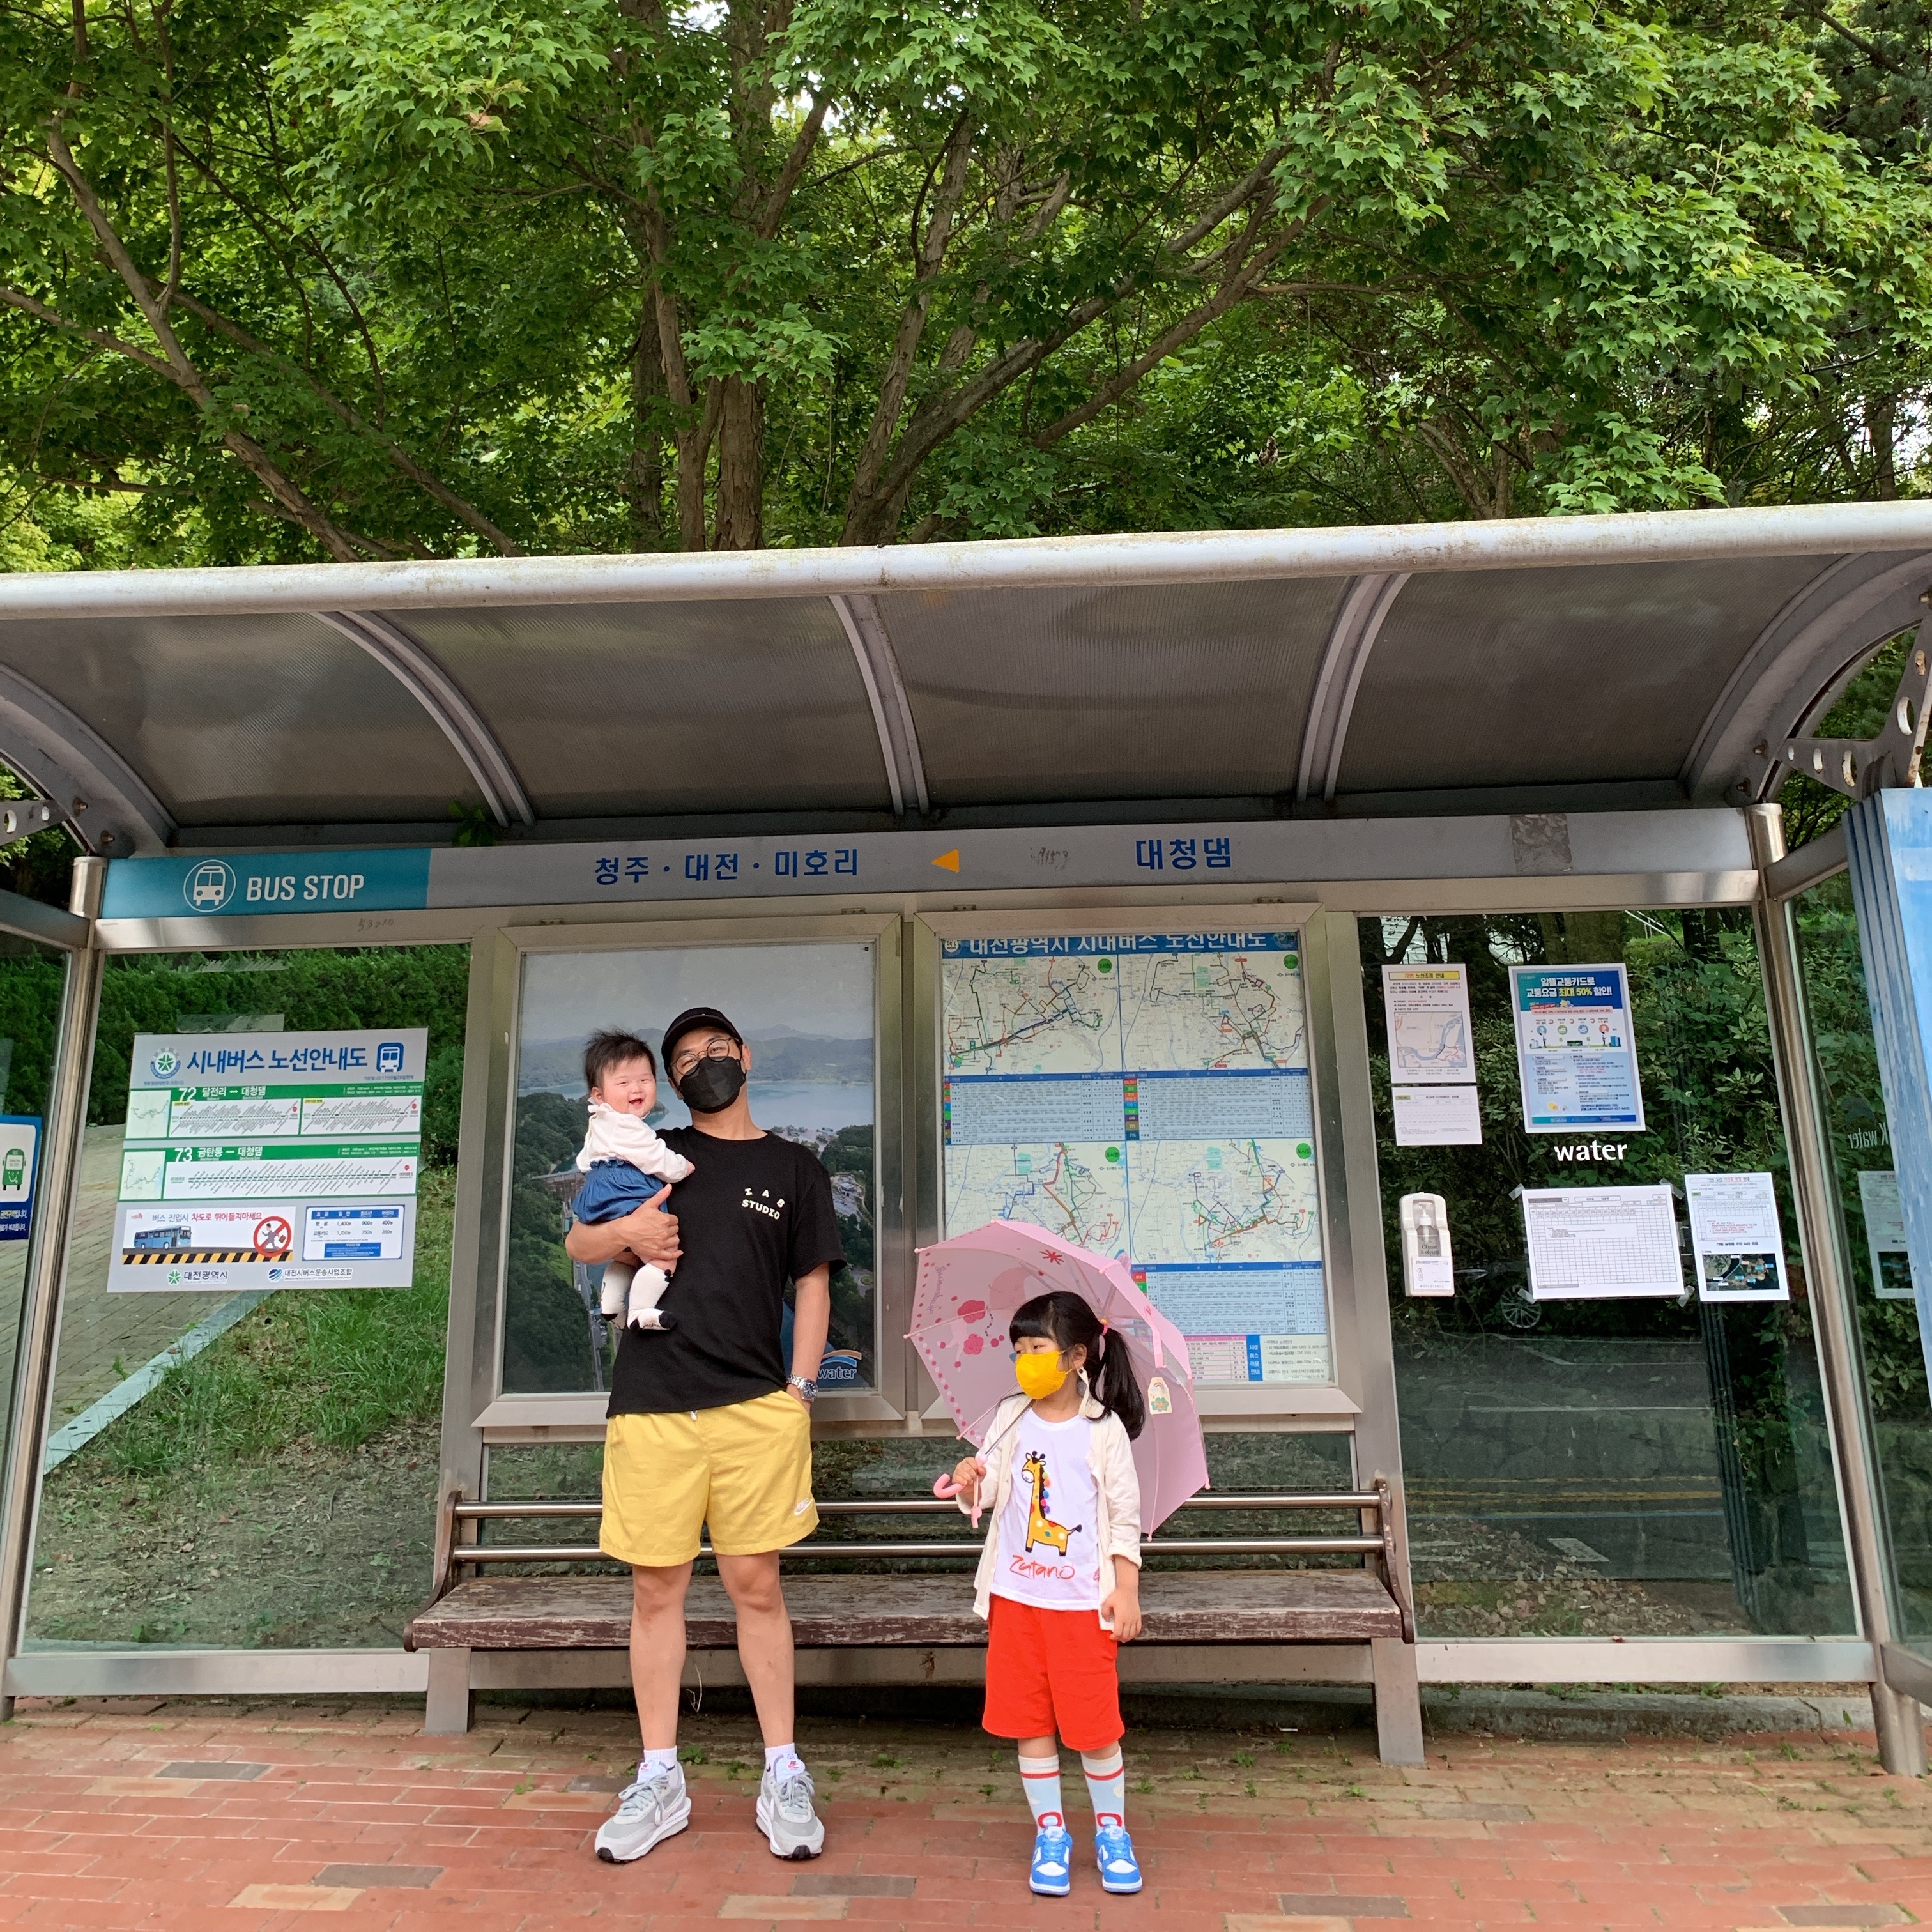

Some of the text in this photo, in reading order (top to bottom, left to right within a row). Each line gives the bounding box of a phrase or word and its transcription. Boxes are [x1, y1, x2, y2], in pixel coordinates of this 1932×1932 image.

[1135, 837, 1232, 870] 대청댐
[594, 848, 859, 885] 청주 대전 미호리
[246, 874, 365, 902] BUS STOP
[1540, 976, 1595, 987] 알뜰교통카드로
[1526, 988, 1557, 998] 교통요금
[1558, 987, 1575, 997] 최대
[1576, 986, 1593, 996] 50%
[187, 1049, 265, 1075] 시내버스
[268, 1046, 368, 1071] 노선안내도
[178, 1085, 266, 1102] 72 달전리 대청댐
[174, 1146, 263, 1162] 73 금탄동 대청댐
[1553, 1140, 1628, 1162] water
[152, 1213, 166, 1222] 버스
[168, 1213, 189, 1222] 진입시
[191, 1213, 212, 1222] 차도로
[215, 1212, 263, 1222] 뛰어들지마세요
[741, 1199, 781, 1220] STUDIO
[183, 1270, 228, 1280] 대전광역시
[284, 1268, 353, 1277] 대전시버스운송사업조합
[818, 1363, 857, 1380] water
